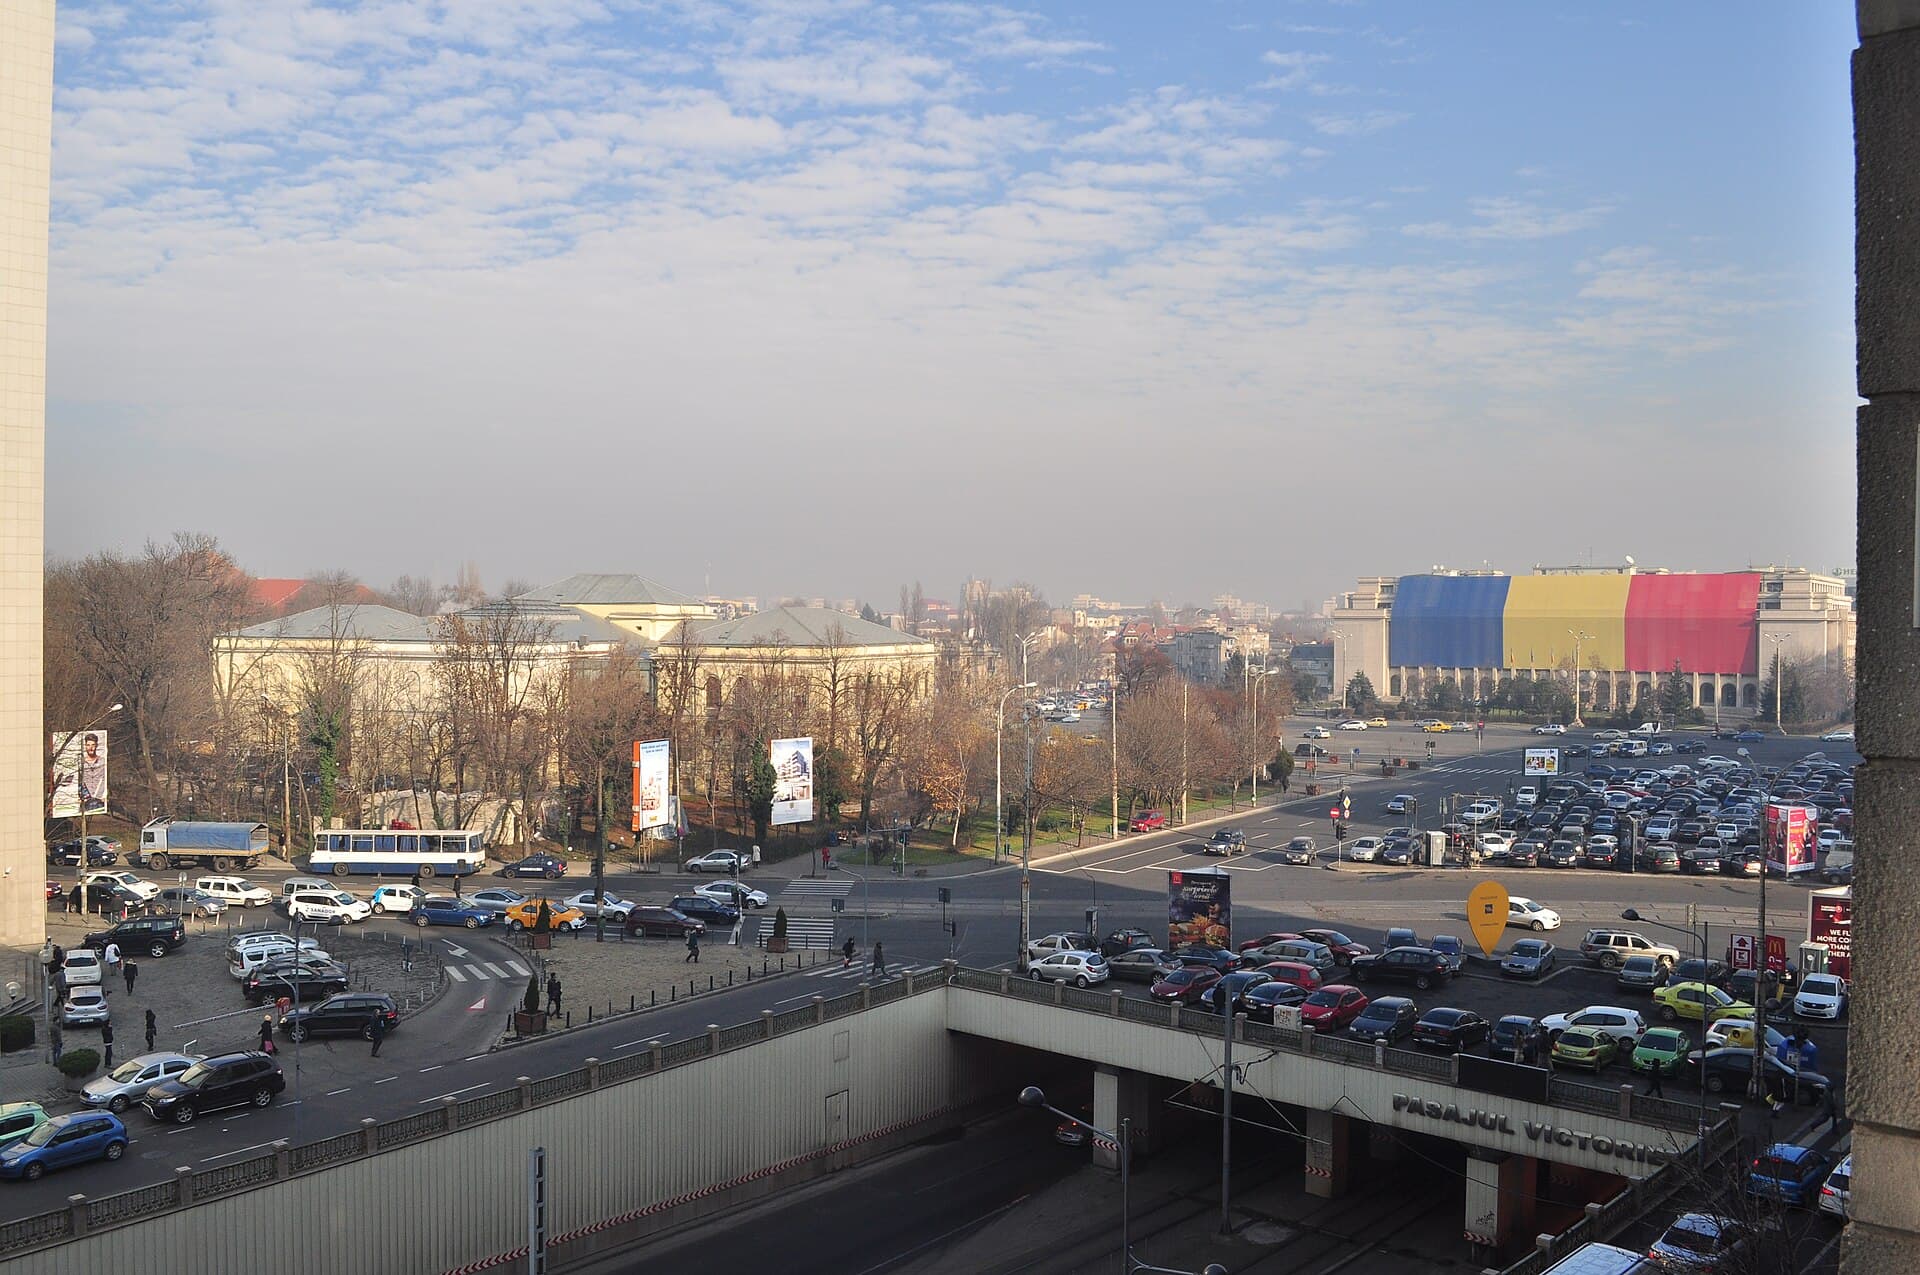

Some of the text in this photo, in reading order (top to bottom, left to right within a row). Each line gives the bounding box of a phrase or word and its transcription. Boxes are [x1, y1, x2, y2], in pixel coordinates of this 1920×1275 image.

[1816, 935, 1838, 943] MORE
[1392, 1092, 1676, 1167] PASAJUL VICTORIE
